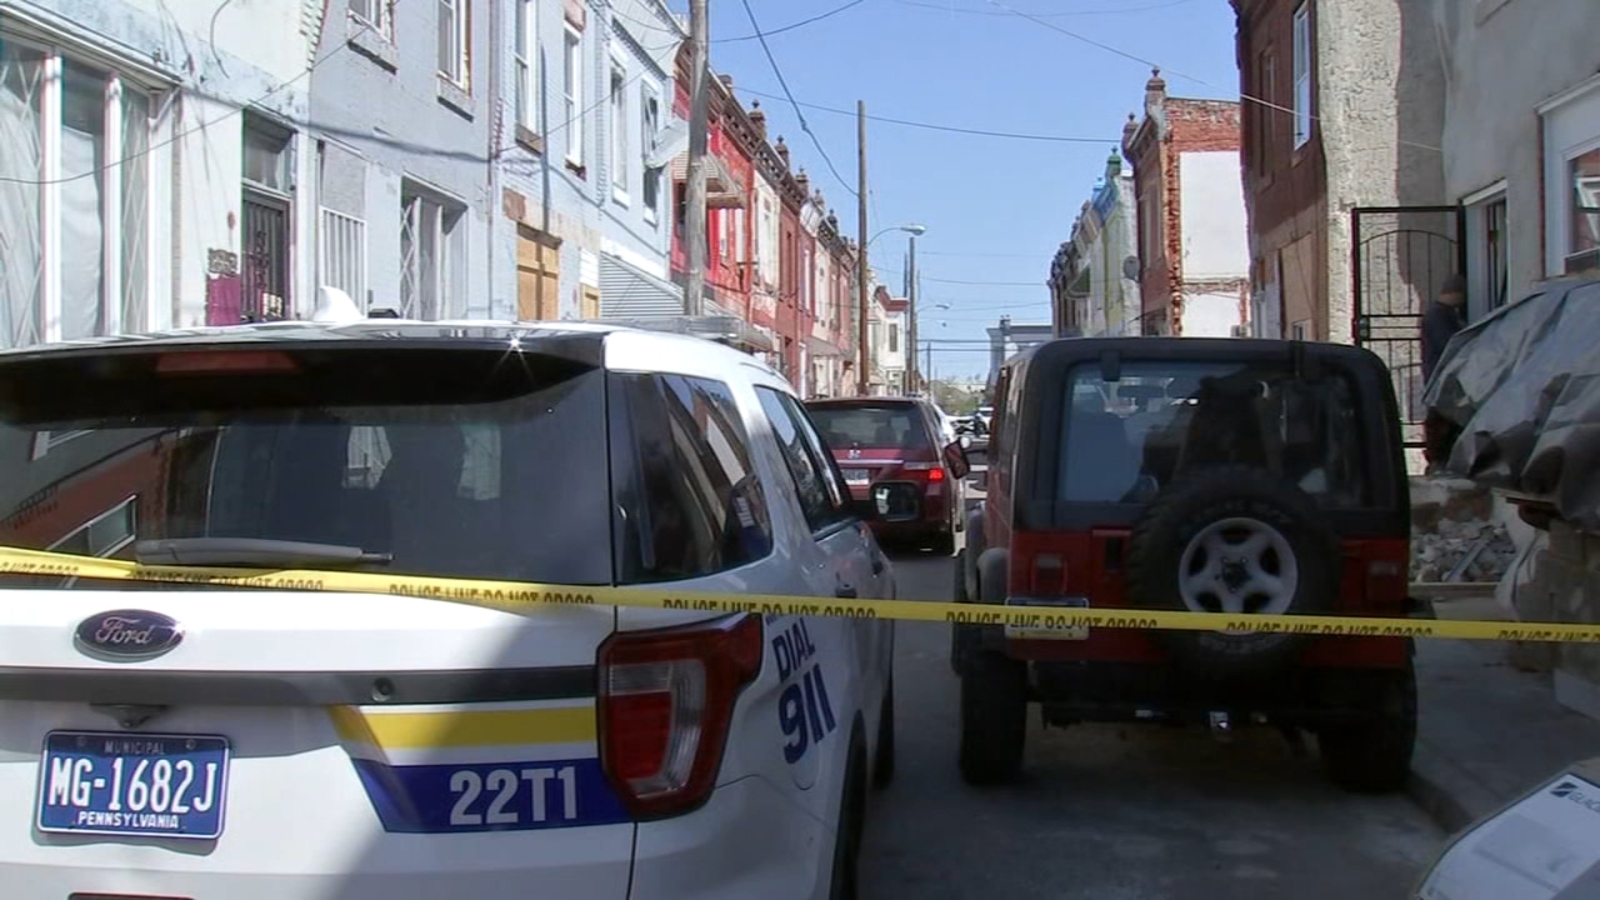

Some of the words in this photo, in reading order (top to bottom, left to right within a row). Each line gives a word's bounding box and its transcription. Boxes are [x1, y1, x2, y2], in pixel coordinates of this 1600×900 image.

[95, 616, 154, 645] Ford
[771, 617, 816, 684] DIAL
[778, 663, 836, 765] 911
[104, 740, 166, 755] MUNICIPAL
[48, 757, 218, 813] MG-1682J
[450, 766, 577, 825] 22T1
[78, 811, 179, 829] PENNSYLVANIA
